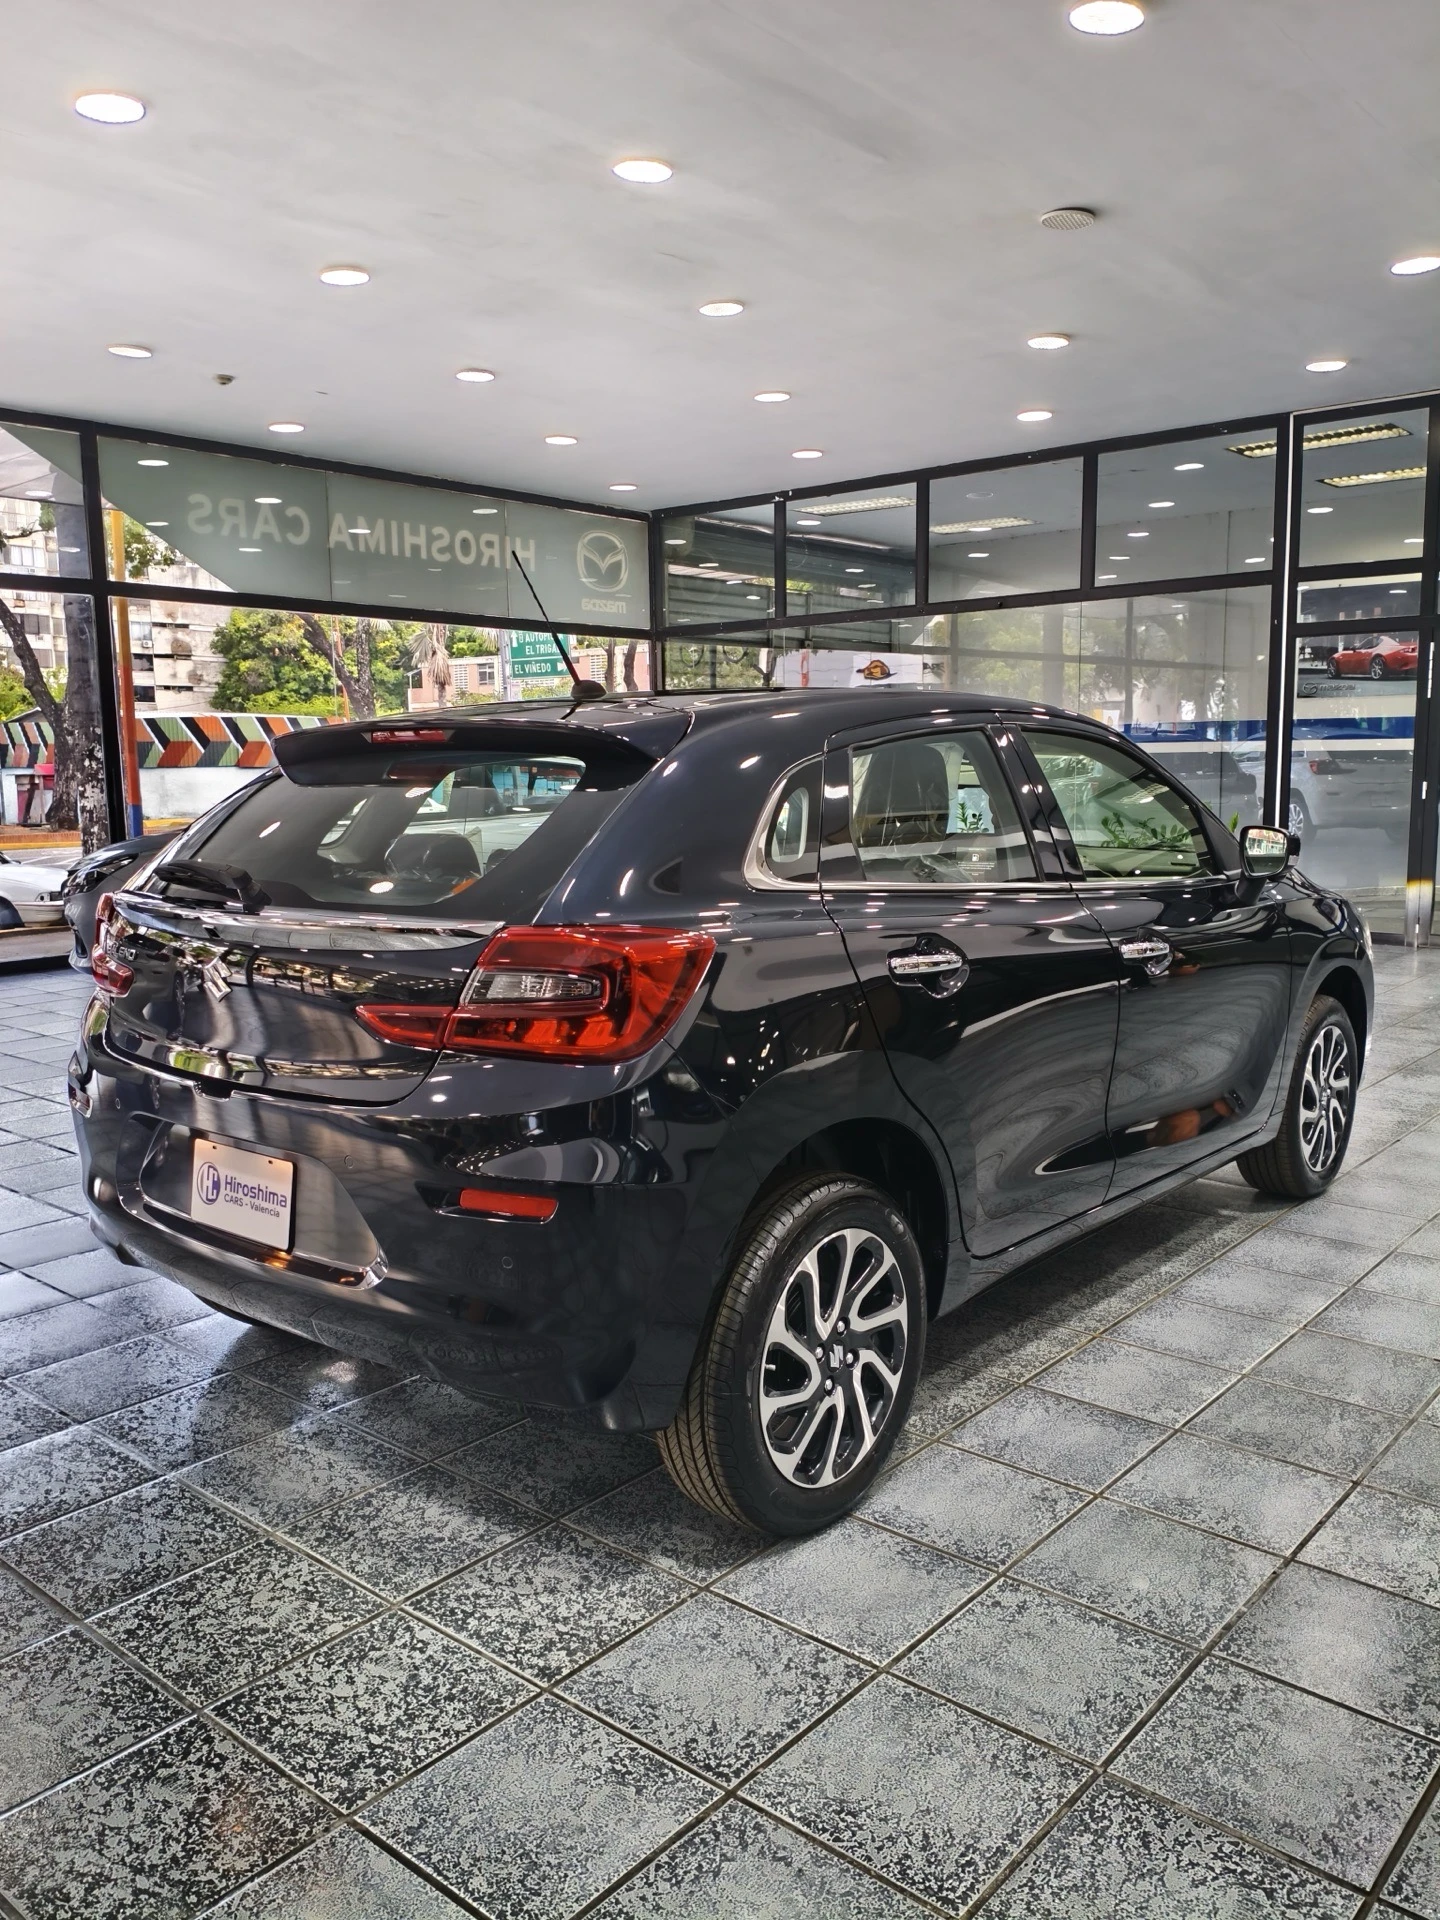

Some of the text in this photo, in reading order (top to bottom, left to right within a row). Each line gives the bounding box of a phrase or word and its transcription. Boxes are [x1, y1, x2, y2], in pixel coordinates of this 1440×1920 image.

[525, 643, 561, 655] EL TRIGA
[514, 661, 552, 674] EL VIÑEDO
[224, 1174, 288, 1208] Hiroshima
[223, 1193, 244, 1207] CARS
[249, 1201, 280, 1218] Valencia
